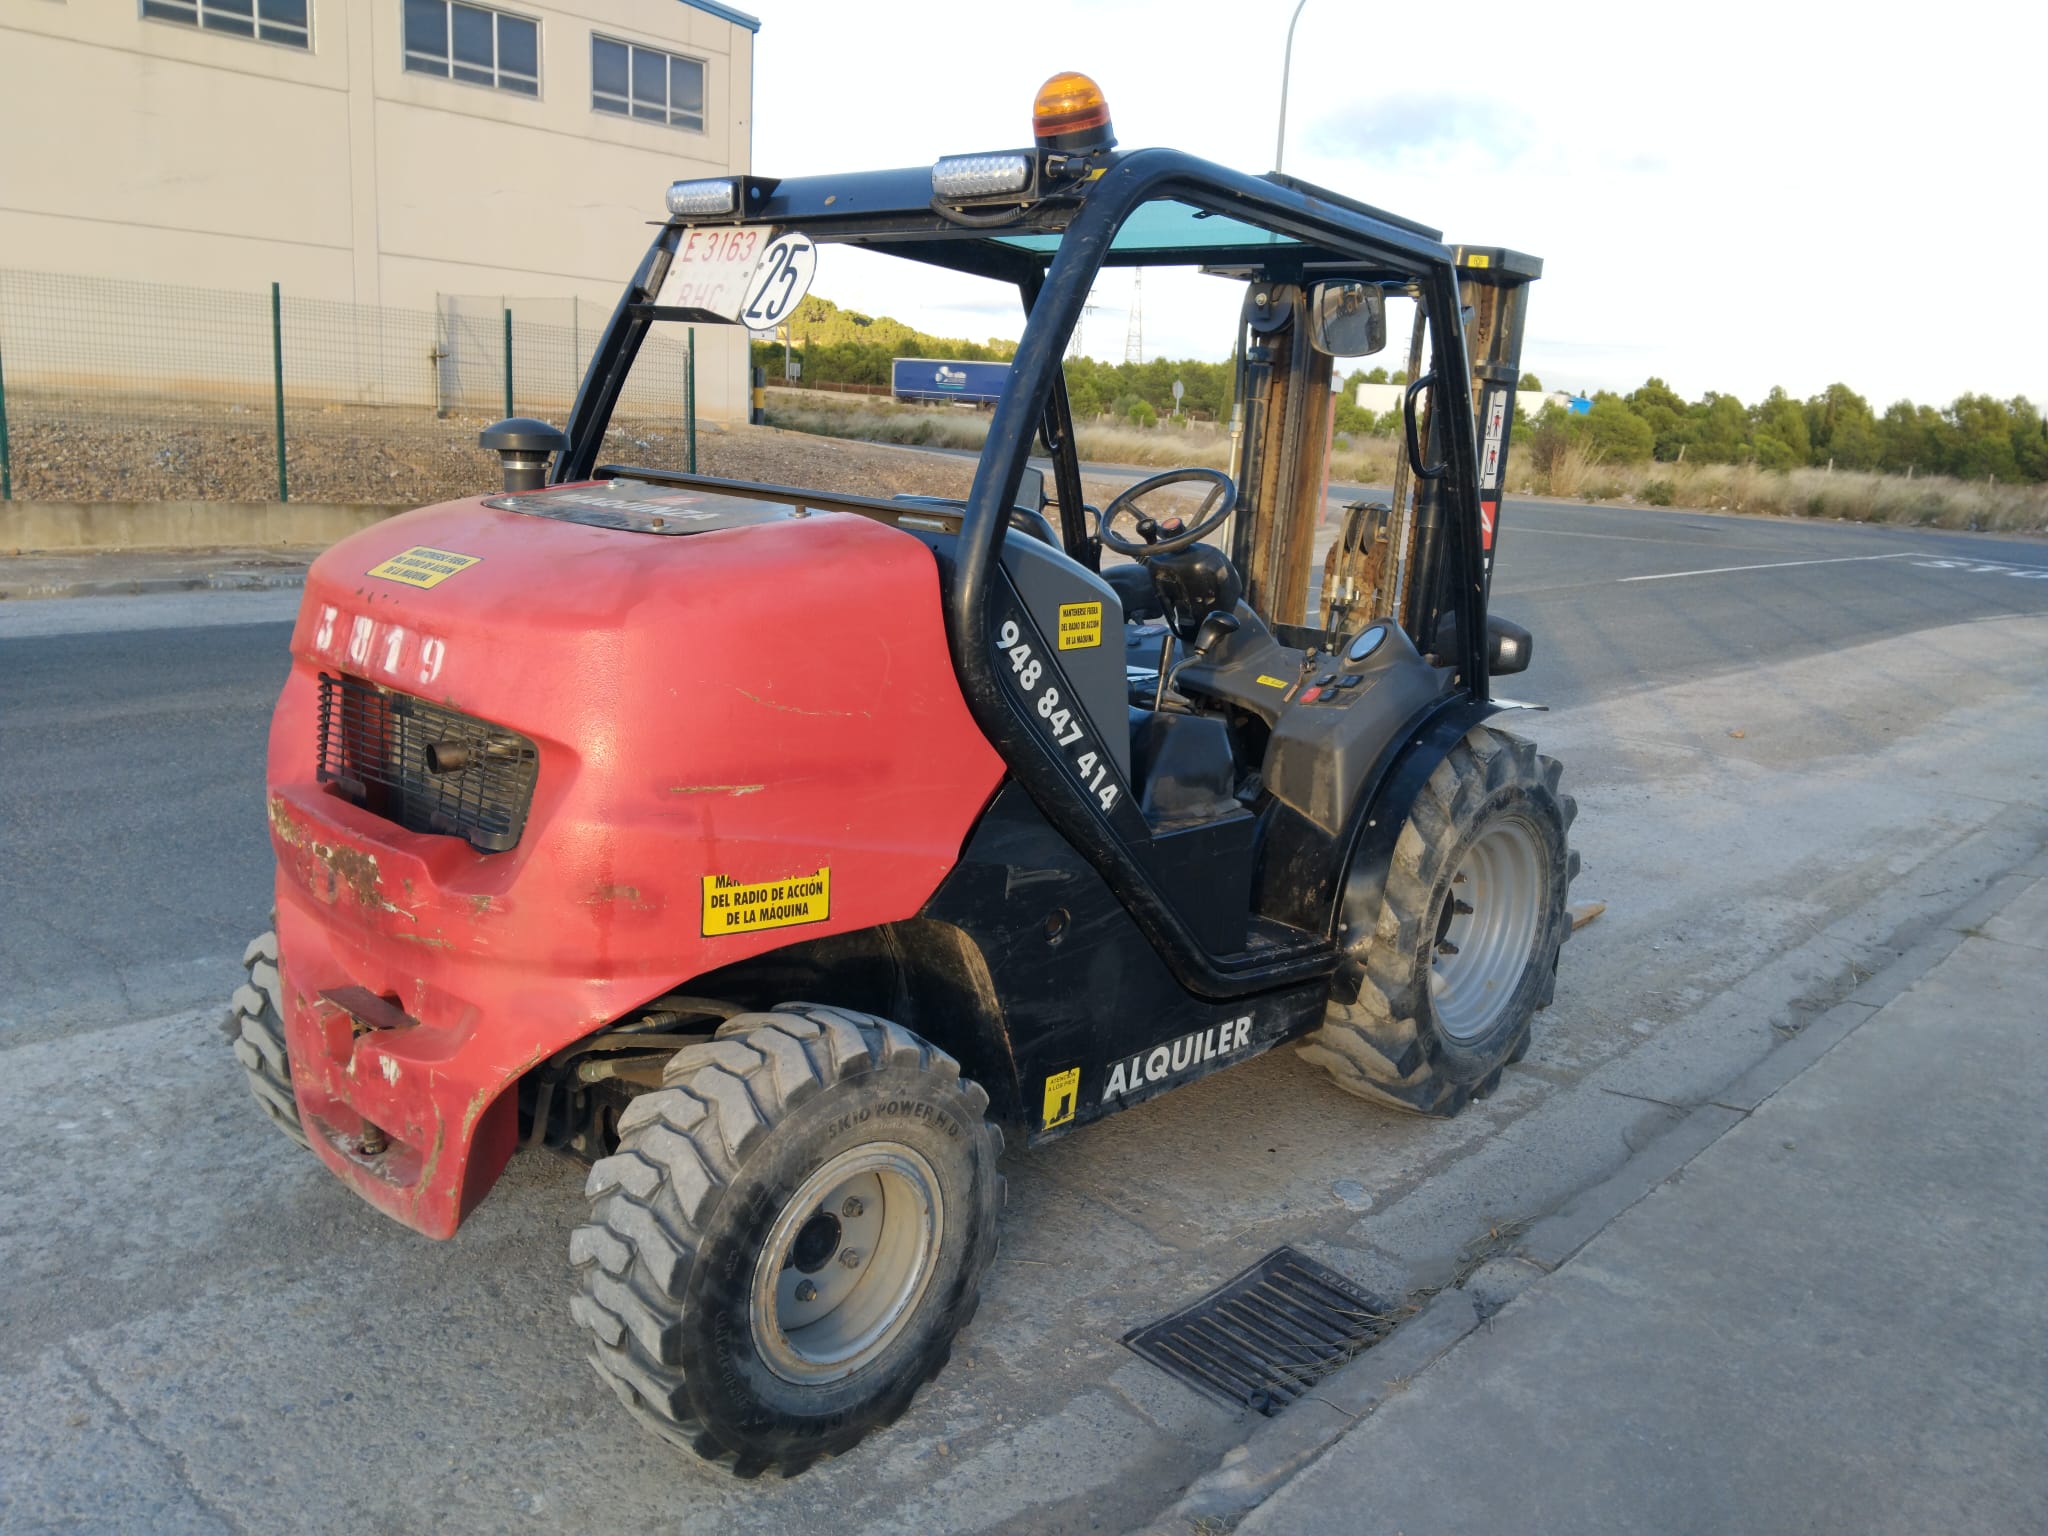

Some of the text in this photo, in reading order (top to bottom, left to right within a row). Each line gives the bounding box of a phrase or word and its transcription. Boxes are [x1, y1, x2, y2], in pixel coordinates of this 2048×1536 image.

[682, 231, 757, 262] E 3163
[746, 243, 810, 319] 25
[996, 620, 1042, 691] 948
[1037, 687, 1084, 747] 847
[1077, 751, 1119, 811] 414
[711, 879, 823, 908] DEL RADIO DE ACCIÓN
[727, 902, 809, 926] DE LA MÁQUINA
[1103, 1016, 1251, 1100] ALQUILER
[828, 1108, 870, 1138] SKID
[873, 1100, 933, 1120] POWER
